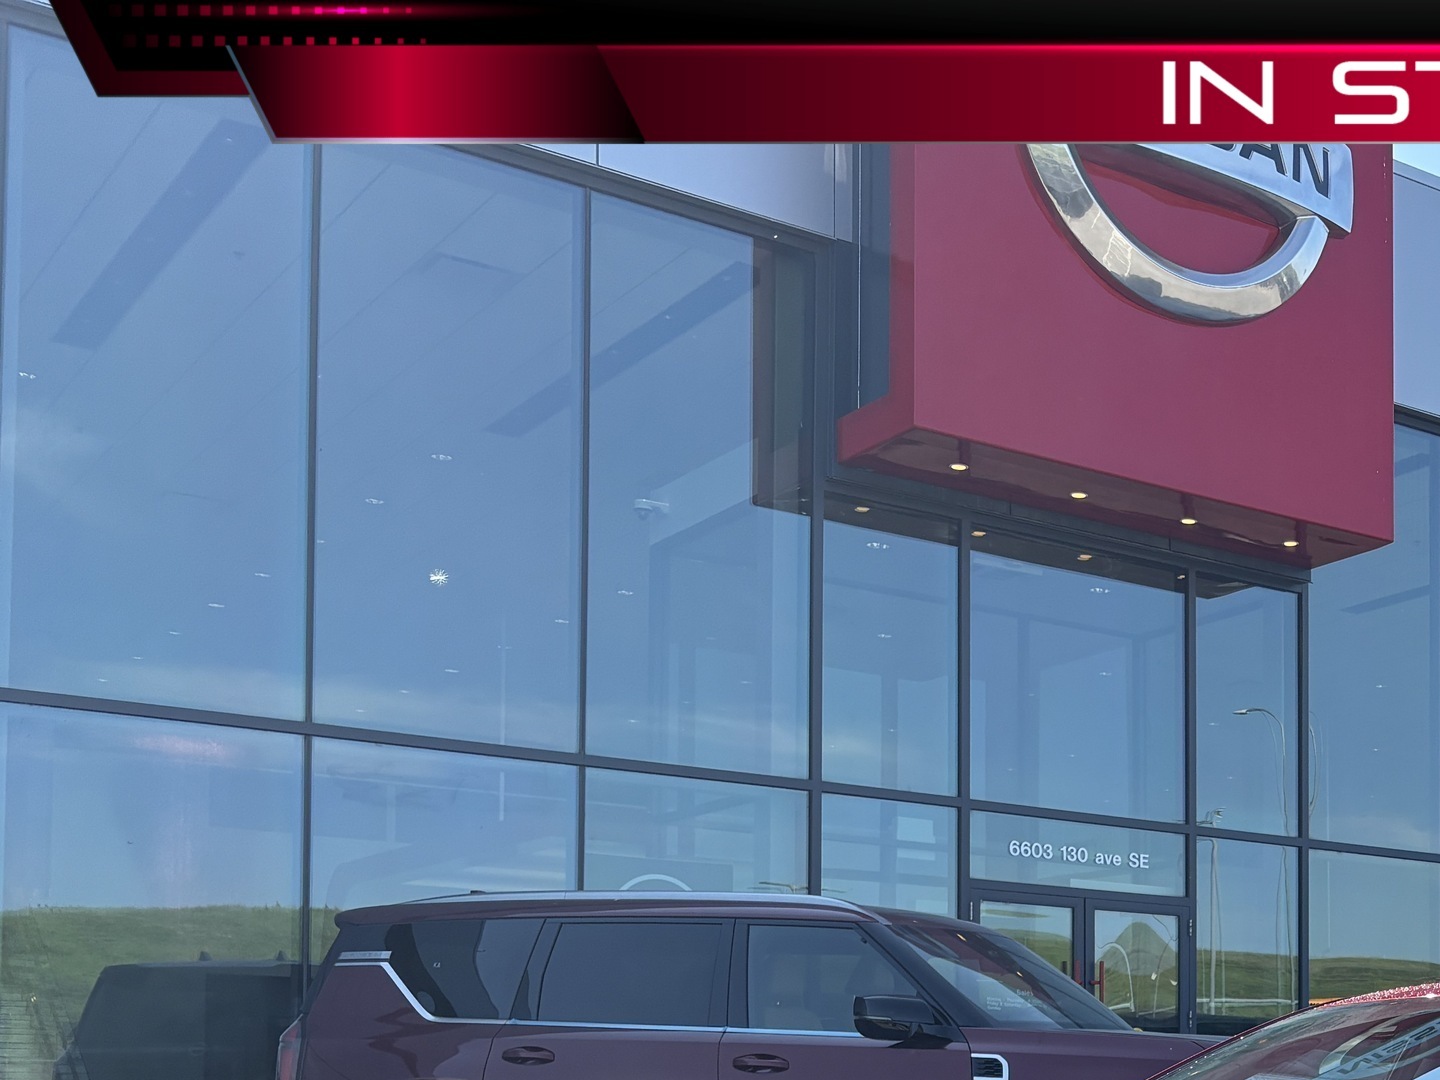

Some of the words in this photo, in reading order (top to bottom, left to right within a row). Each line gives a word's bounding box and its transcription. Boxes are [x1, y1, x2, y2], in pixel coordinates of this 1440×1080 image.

[1009, 840, 1053, 859] 6603
[1060, 846, 1088, 863] 130
[1095, 852, 1122, 866] ave
[1128, 852, 1149, 869] SE
